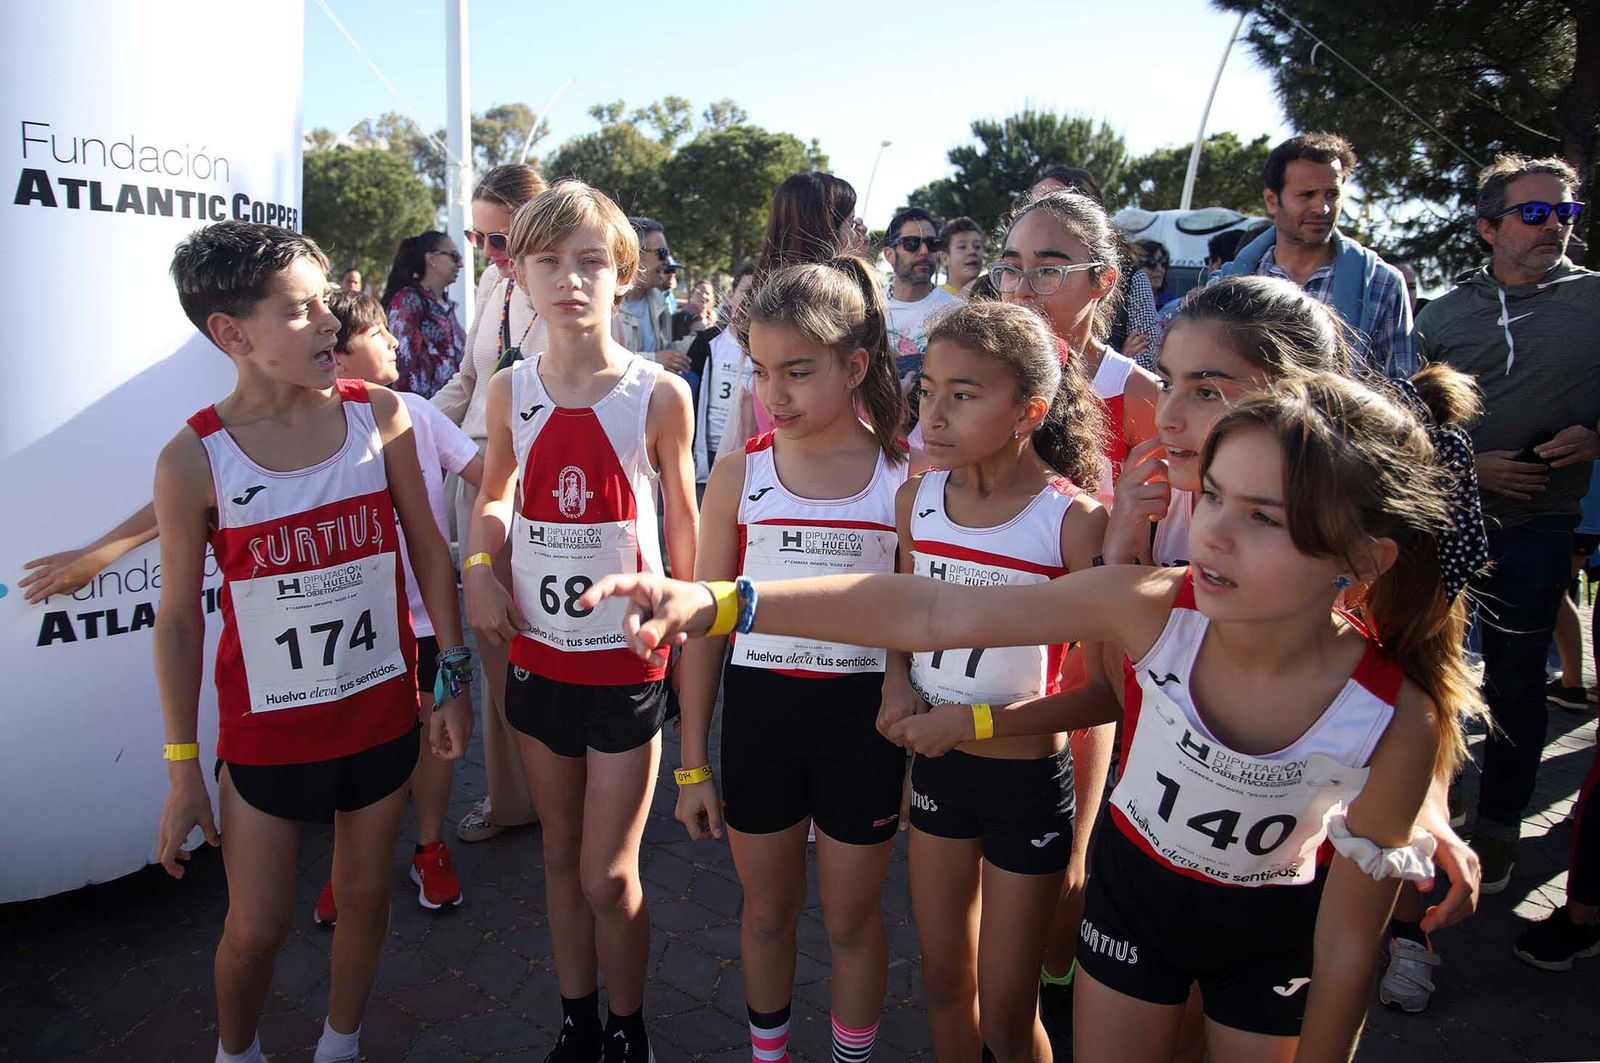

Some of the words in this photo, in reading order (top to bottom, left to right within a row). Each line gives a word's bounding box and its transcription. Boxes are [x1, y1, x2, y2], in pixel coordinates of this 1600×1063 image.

[22, 120, 230, 183] Fundación
[13, 168, 227, 222] ATLANTIC
[249, 505, 382, 568] CURTIUS
[547, 526, 602, 537] DIPUTACIÓN
[562, 536, 601, 544] HUELVA
[805, 531, 864, 543] DIPUTACIÓN
[805, 548, 841, 556] OBJETIVOS
[822, 541, 862, 550] HUELVA
[303, 563, 362, 584] DIPUTACIÓN
[304, 583, 318, 592] DE
[323, 572, 362, 588] HUELVA
[948, 573, 960, 583] DE
[949, 564, 1009, 583] DIPUTACIÓN
[306, 586, 344, 598] OBJETIVOS
[540, 575, 595, 618] 68
[275, 608, 377, 670] 174
[567, 639, 583, 647] tus
[746, 649, 783, 663] Huelva
[785, 652, 814, 665] eleva
[816, 656, 834, 667] tus
[836, 656, 879, 668] sentidos.
[266, 691, 306, 706] Huelva
[309, 686, 338, 700] eleva
[340, 681, 355, 693] tus
[355, 663, 398, 686] sentidos.
[1213, 759, 1233, 773] DE
[1240, 769, 1303, 782] HUELVA
[1215, 750, 1308, 774] DIPUTACIÓN
[1211, 766, 1271, 788] OBJETIVOS
[1156, 770, 1297, 856] 140
[1126, 799, 1160, 848] Huelva
[1161, 846, 1200, 869] eleva
[1204, 865, 1230, 881] tus
[1080, 918, 1138, 964] CURTIUS
